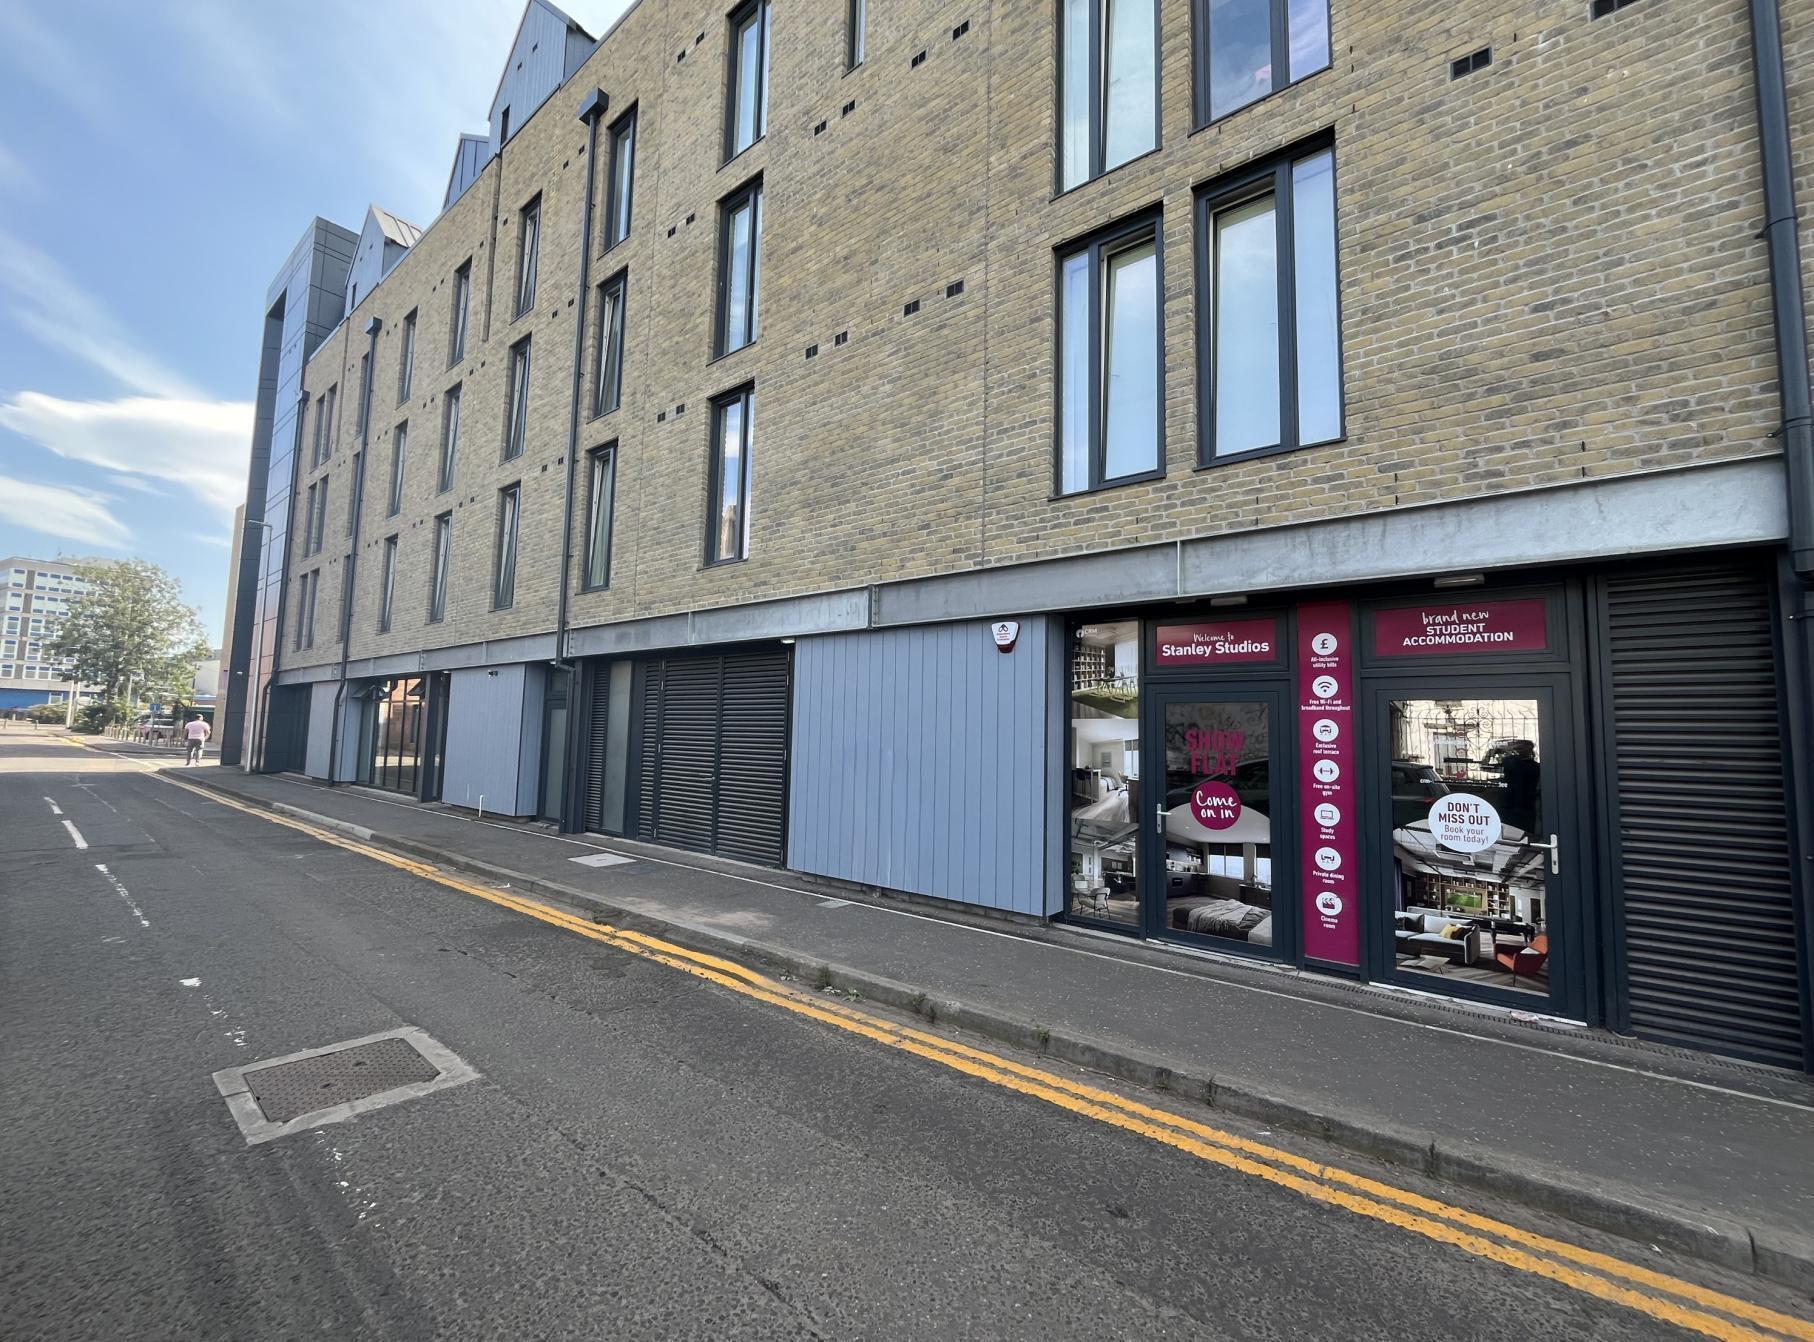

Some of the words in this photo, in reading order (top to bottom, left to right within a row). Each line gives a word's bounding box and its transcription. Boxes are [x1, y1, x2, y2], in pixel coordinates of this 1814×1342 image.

[1422, 610, 1459, 625] brand
[1463, 610, 1489, 621] new
[1427, 623, 1486, 635] STUDENT
[1193, 633, 1225, 642] Welcome
[1227, 632, 1234, 642] to
[1403, 632, 1514, 646] ACCOMMODATION
[1162, 643, 1212, 657] Stanley
[1215, 640, 1270, 654] Studios
[1185, 729, 1246, 752] SHOW
[1190, 751, 1241, 776] FLAT
[1196, 790, 1237, 807] Come
[1201, 808, 1216, 818] on
[1220, 805, 1234, 819] in
[1447, 801, 1480, 813] DON'T
[1438, 812, 1465, 824] MISS
[1468, 815, 1490, 826] OUT
[1444, 824, 1463, 835] Book
[1466, 827, 1484, 837] your
[1440, 834, 1461, 842] room
[1463, 835, 1488, 846] today!
[1321, 915, 1338, 923] Cinema
